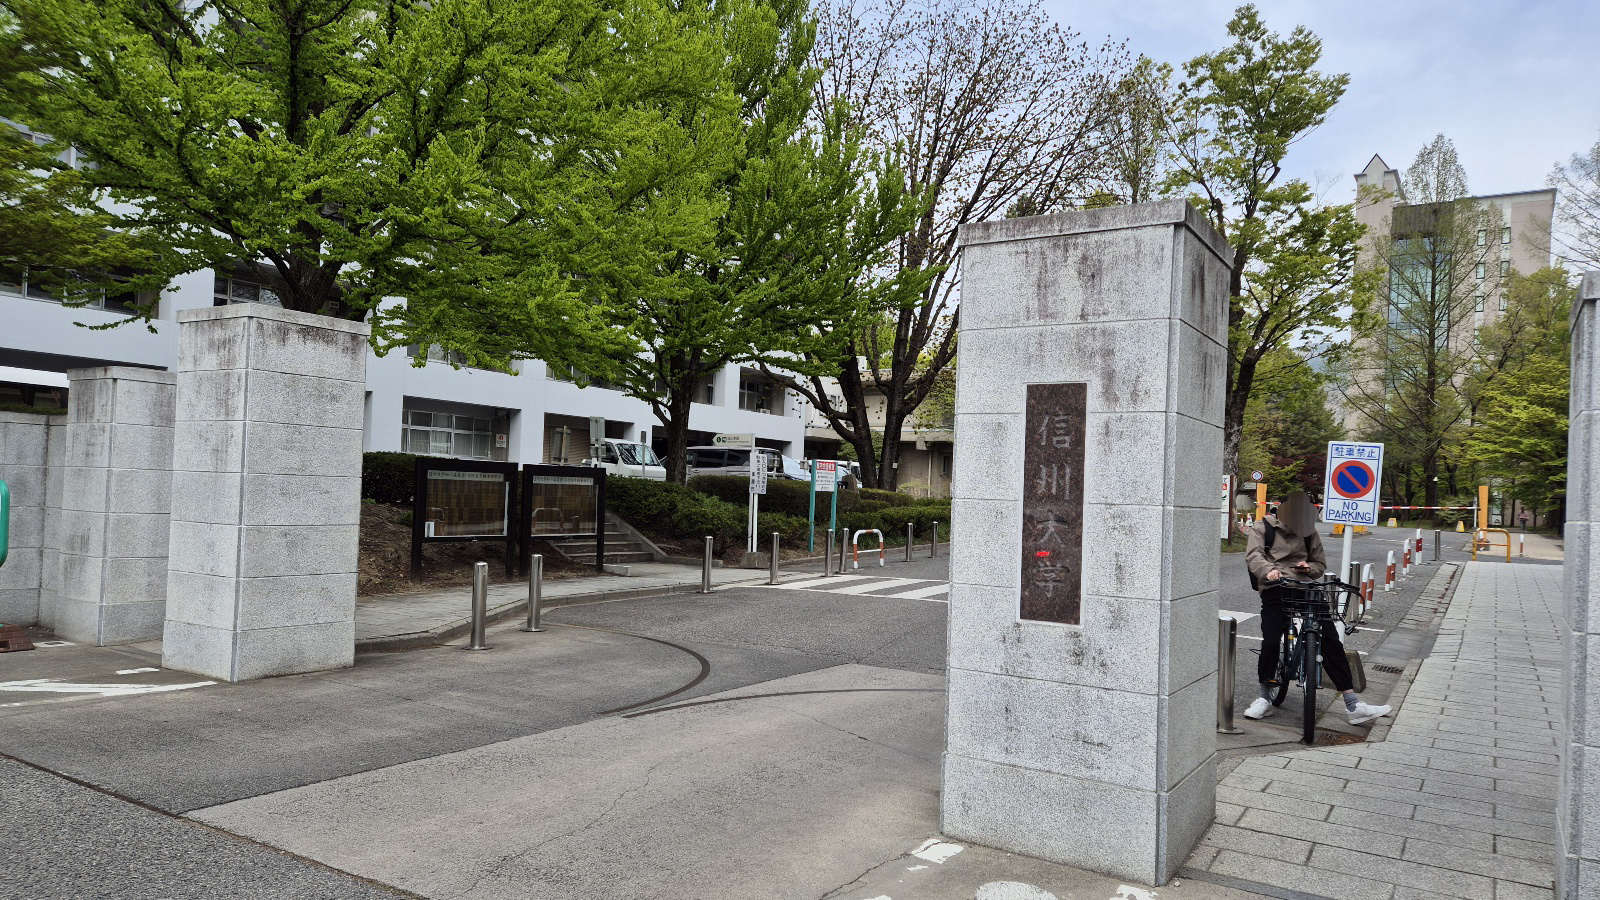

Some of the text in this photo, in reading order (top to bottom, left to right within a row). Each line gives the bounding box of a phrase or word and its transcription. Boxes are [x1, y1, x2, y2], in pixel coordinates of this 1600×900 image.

[1335, 447, 1376, 458] 駐車禁止
[1034, 412, 1073, 598] 信州大学
[1343, 501, 1358, 511] NO
[1328, 509, 1371, 522] PARKING
